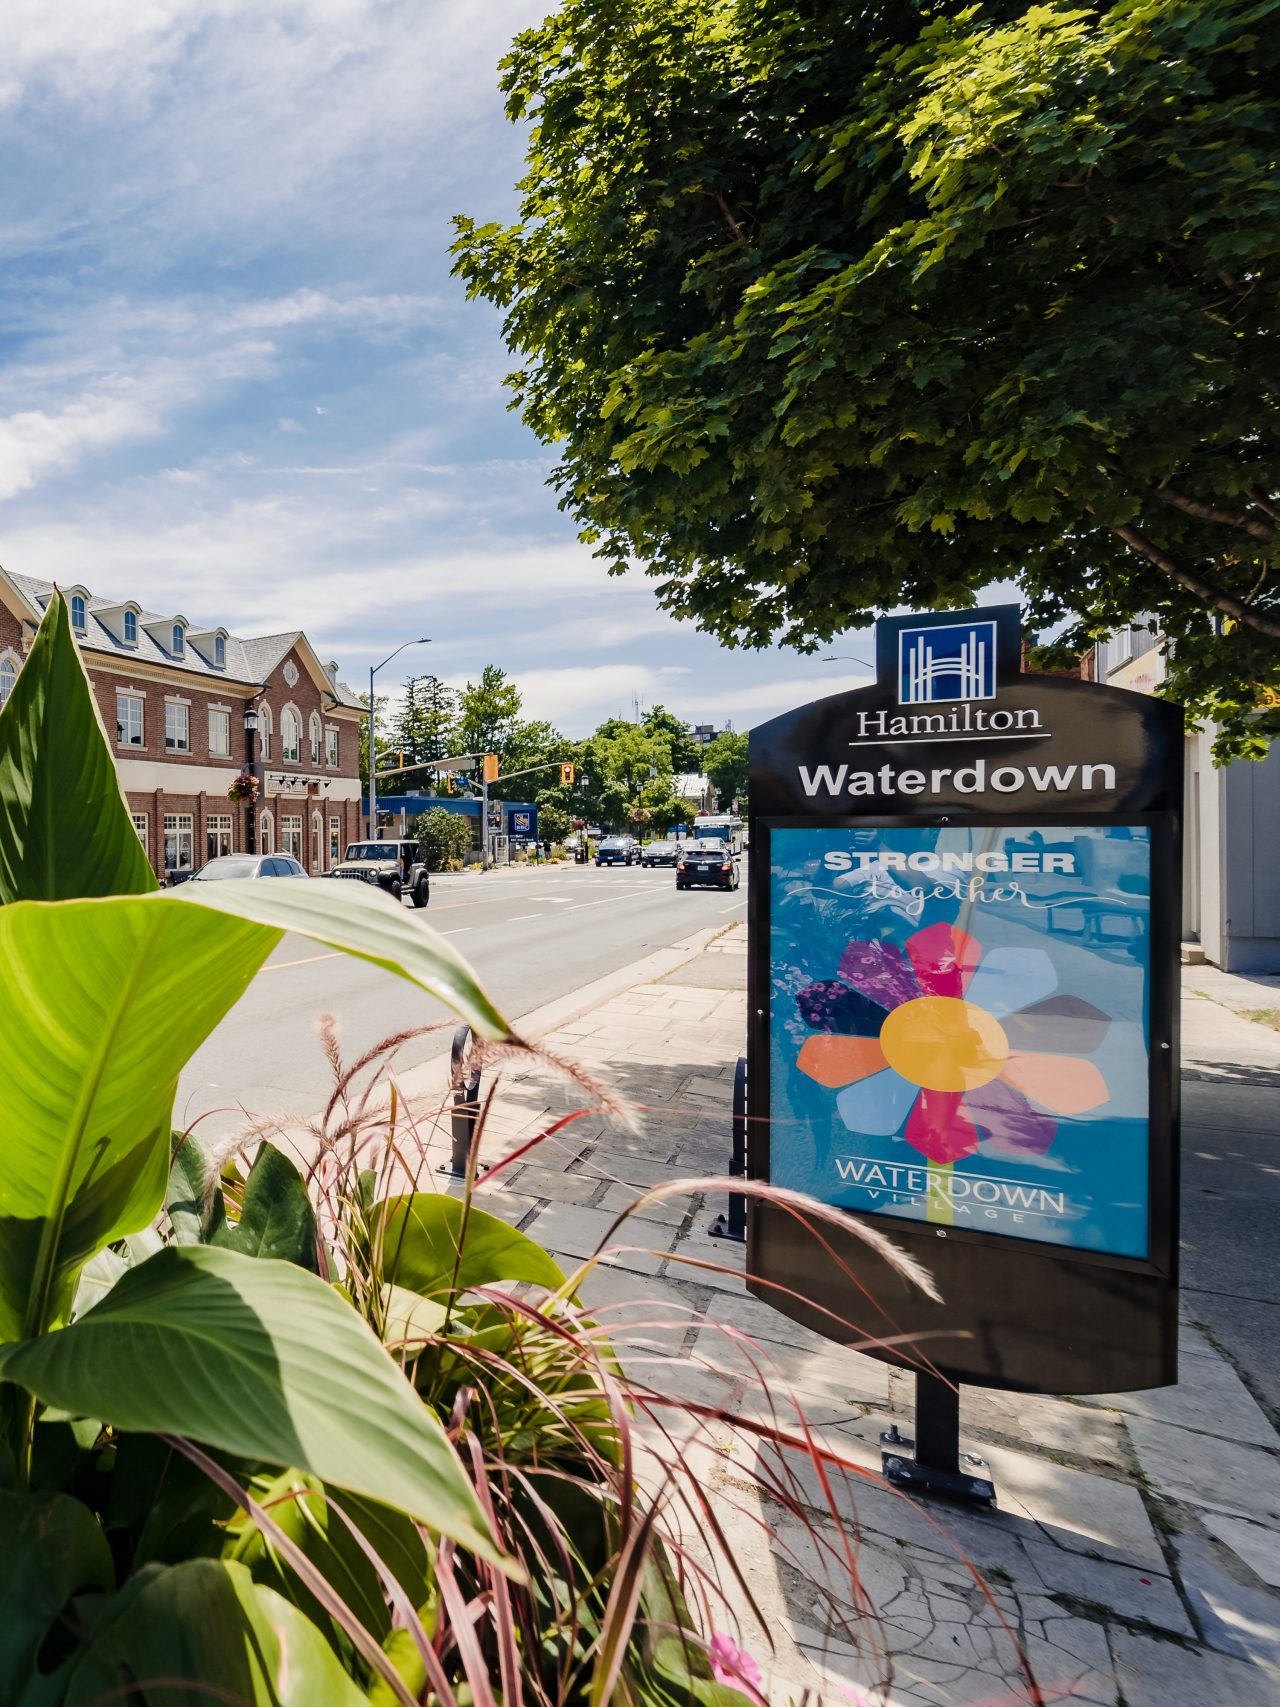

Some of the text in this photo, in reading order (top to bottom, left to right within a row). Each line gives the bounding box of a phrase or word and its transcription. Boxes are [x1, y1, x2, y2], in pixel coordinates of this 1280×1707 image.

[856, 703, 1044, 737] Hamilton
[798, 759, 1117, 797] Waterdown
[823, 850, 1075, 873] STRONGER
[830, 876, 1065, 915] together
[835, 1159, 1065, 1214] WATERDOWN
[868, 1190, 1025, 1224] VILLAGE
